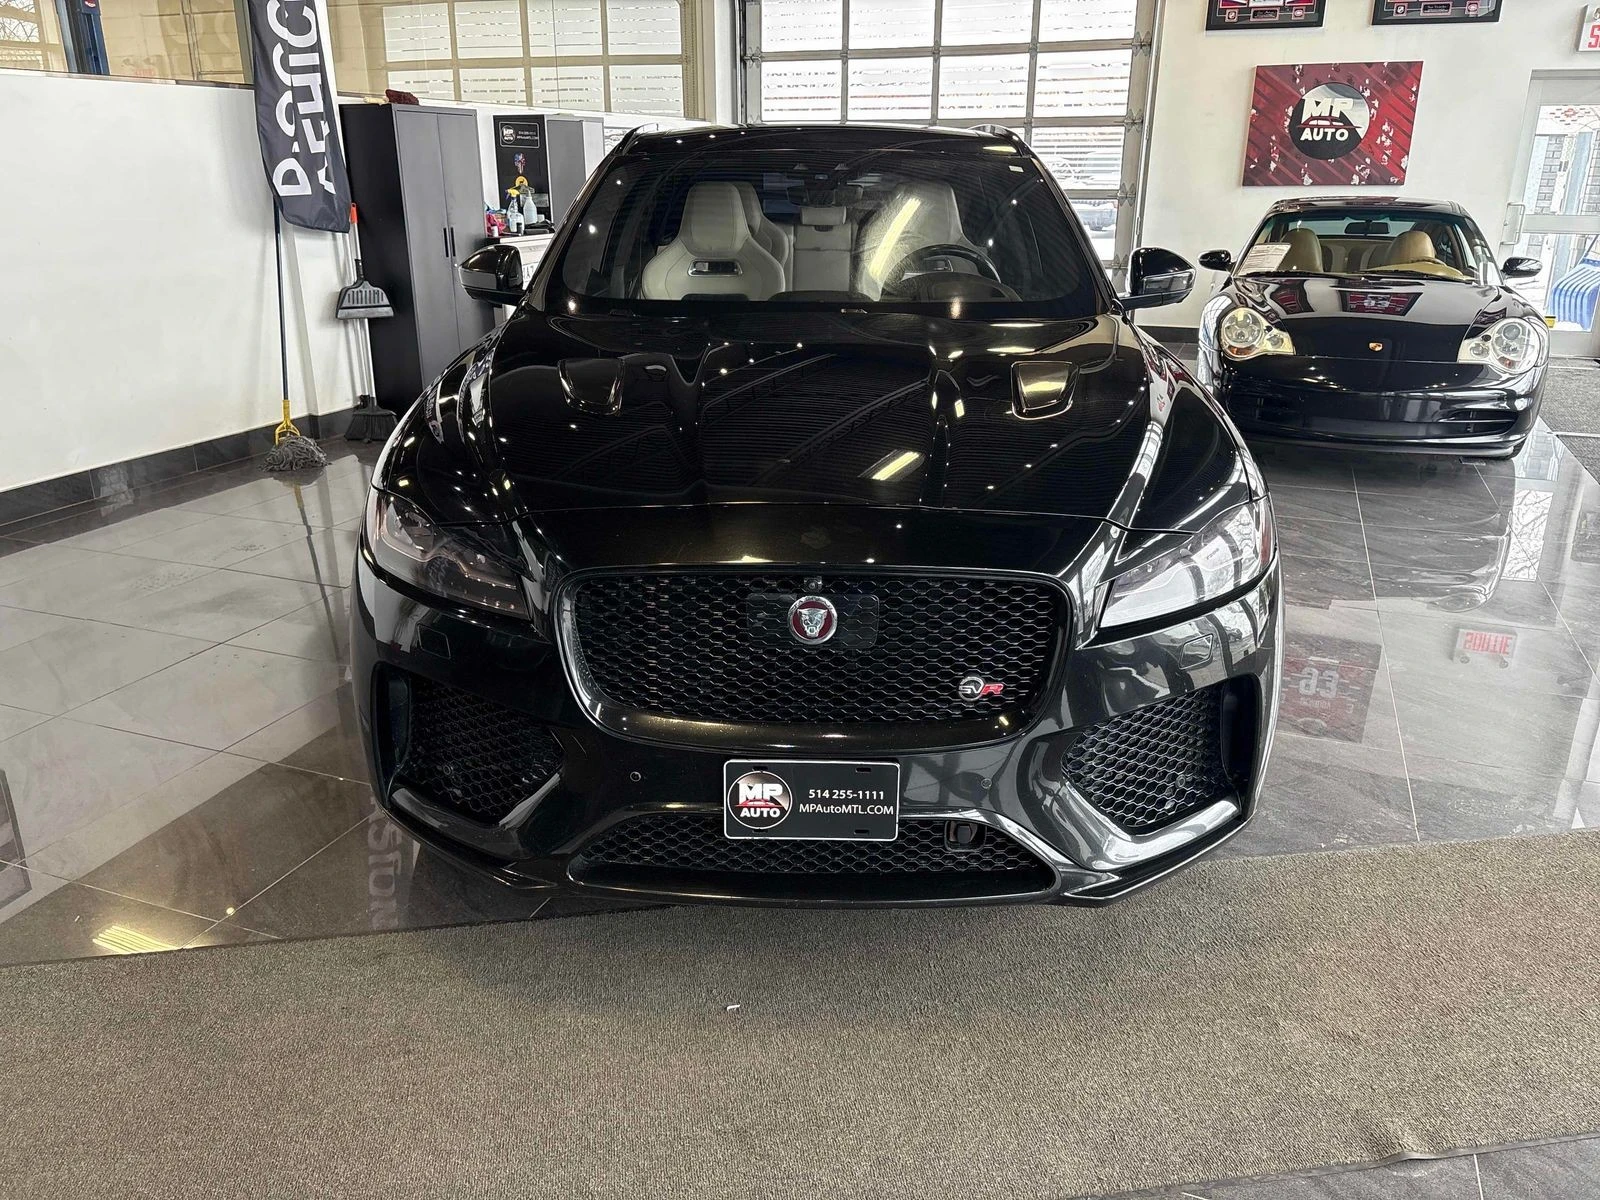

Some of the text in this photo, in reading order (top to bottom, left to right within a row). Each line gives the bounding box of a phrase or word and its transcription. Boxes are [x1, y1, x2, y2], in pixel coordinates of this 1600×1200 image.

[1300, 127, 1349, 141] AUTO
[808, 789, 884, 800] 514 255-1111
[740, 807, 780, 818] AUTO
[799, 803, 894, 815] MPAutoMTL.COM
